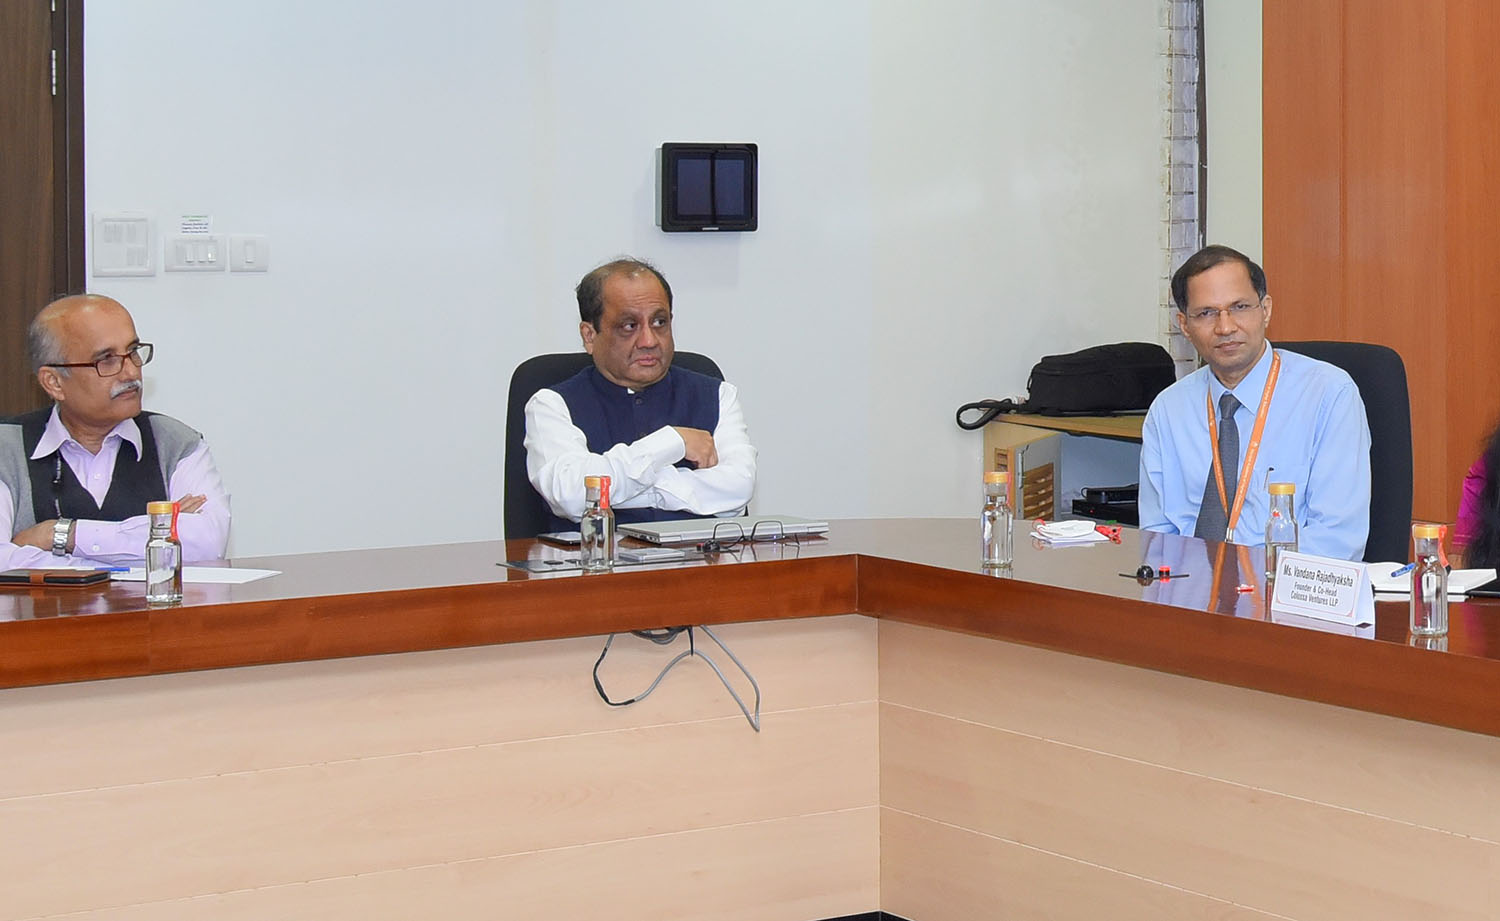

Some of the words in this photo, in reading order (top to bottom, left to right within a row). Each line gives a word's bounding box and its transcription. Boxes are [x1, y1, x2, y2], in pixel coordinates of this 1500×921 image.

[1283, 564, 1292, 577] Ms.
[1294, 566, 1316, 581] Vandana
[1294, 582, 1312, 593] Founder
[1318, 586, 1338, 597] Co-Head
[1309, 594, 1329, 606] Ventures
[1329, 598, 1339, 607] LLP
